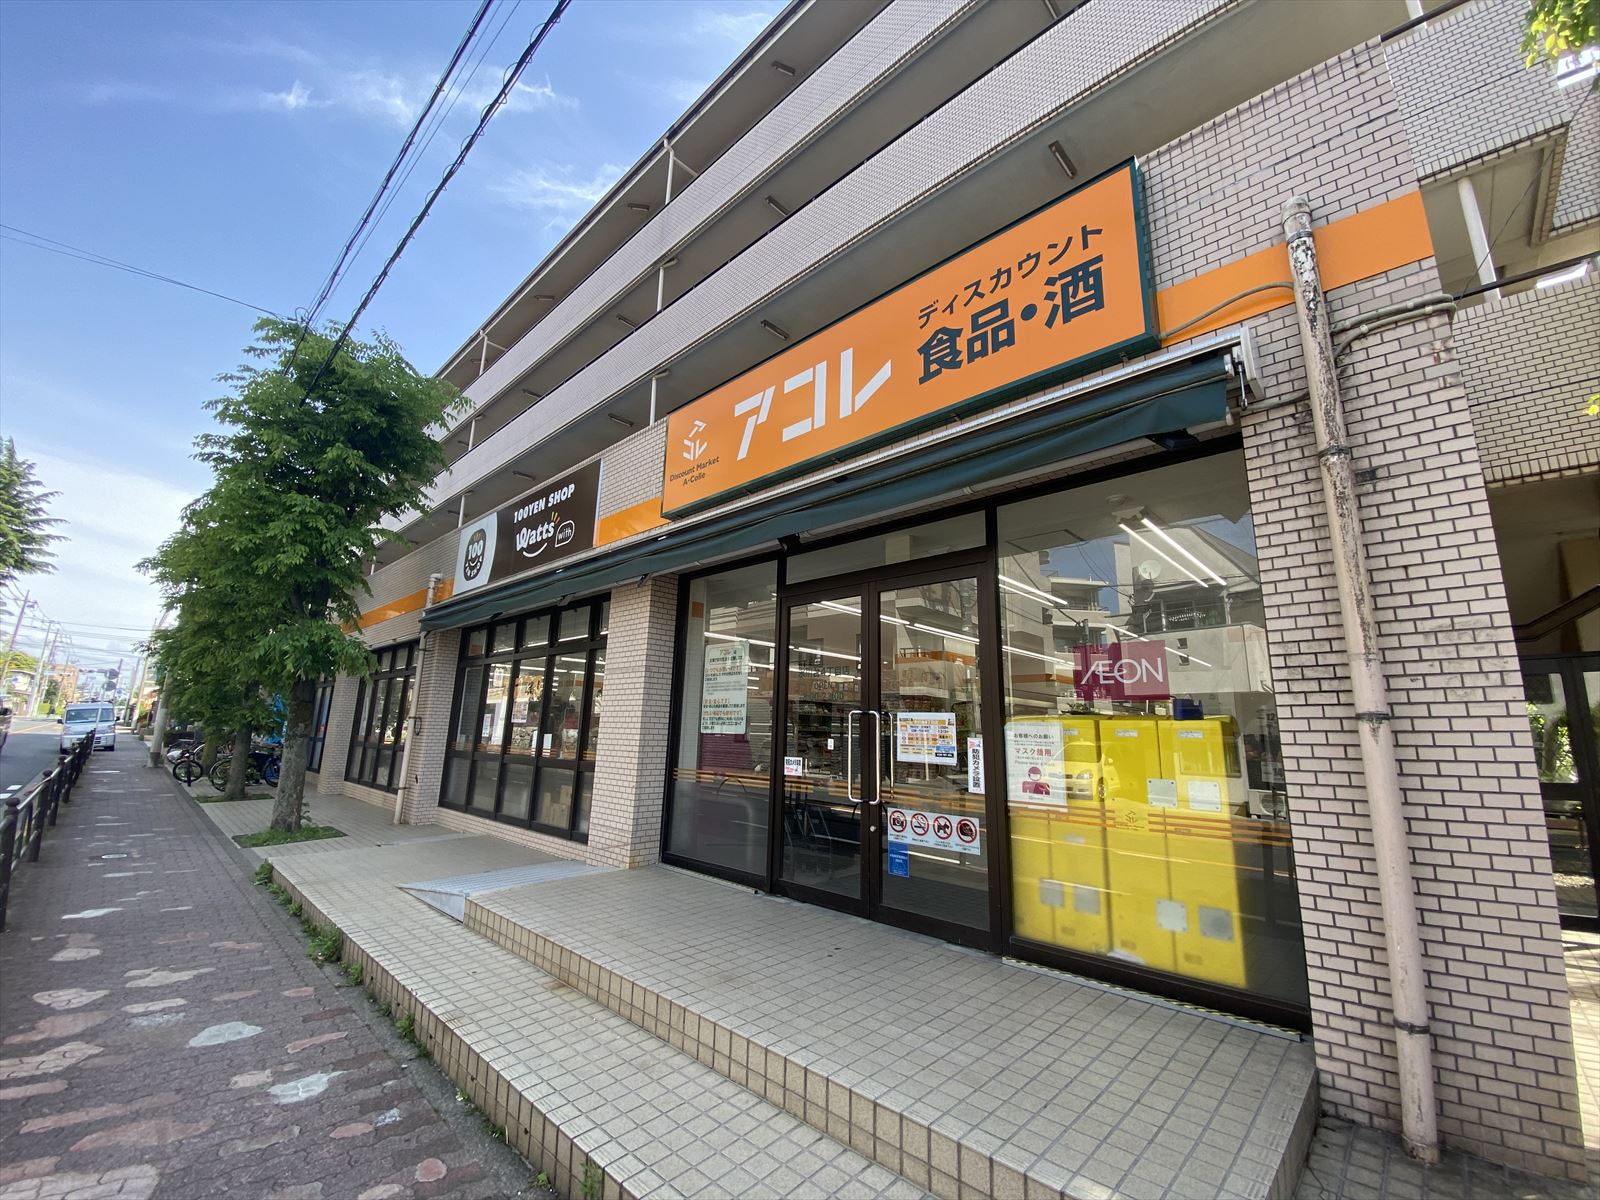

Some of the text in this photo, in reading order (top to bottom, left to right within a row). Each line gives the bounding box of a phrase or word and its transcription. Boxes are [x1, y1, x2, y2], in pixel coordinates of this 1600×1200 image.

[918, 224, 1103, 330] ディスカウント
[734, 347, 892, 461] アコレ
[669, 456, 720, 482] Discount Market
[513, 483, 576, 523] 100YEN SHOP
[467, 540, 484, 560] 100
[516, 521, 555, 552] Watts
[558, 527, 572, 540] with
[972, 748, 981, 788] 防犯カメラ設置
